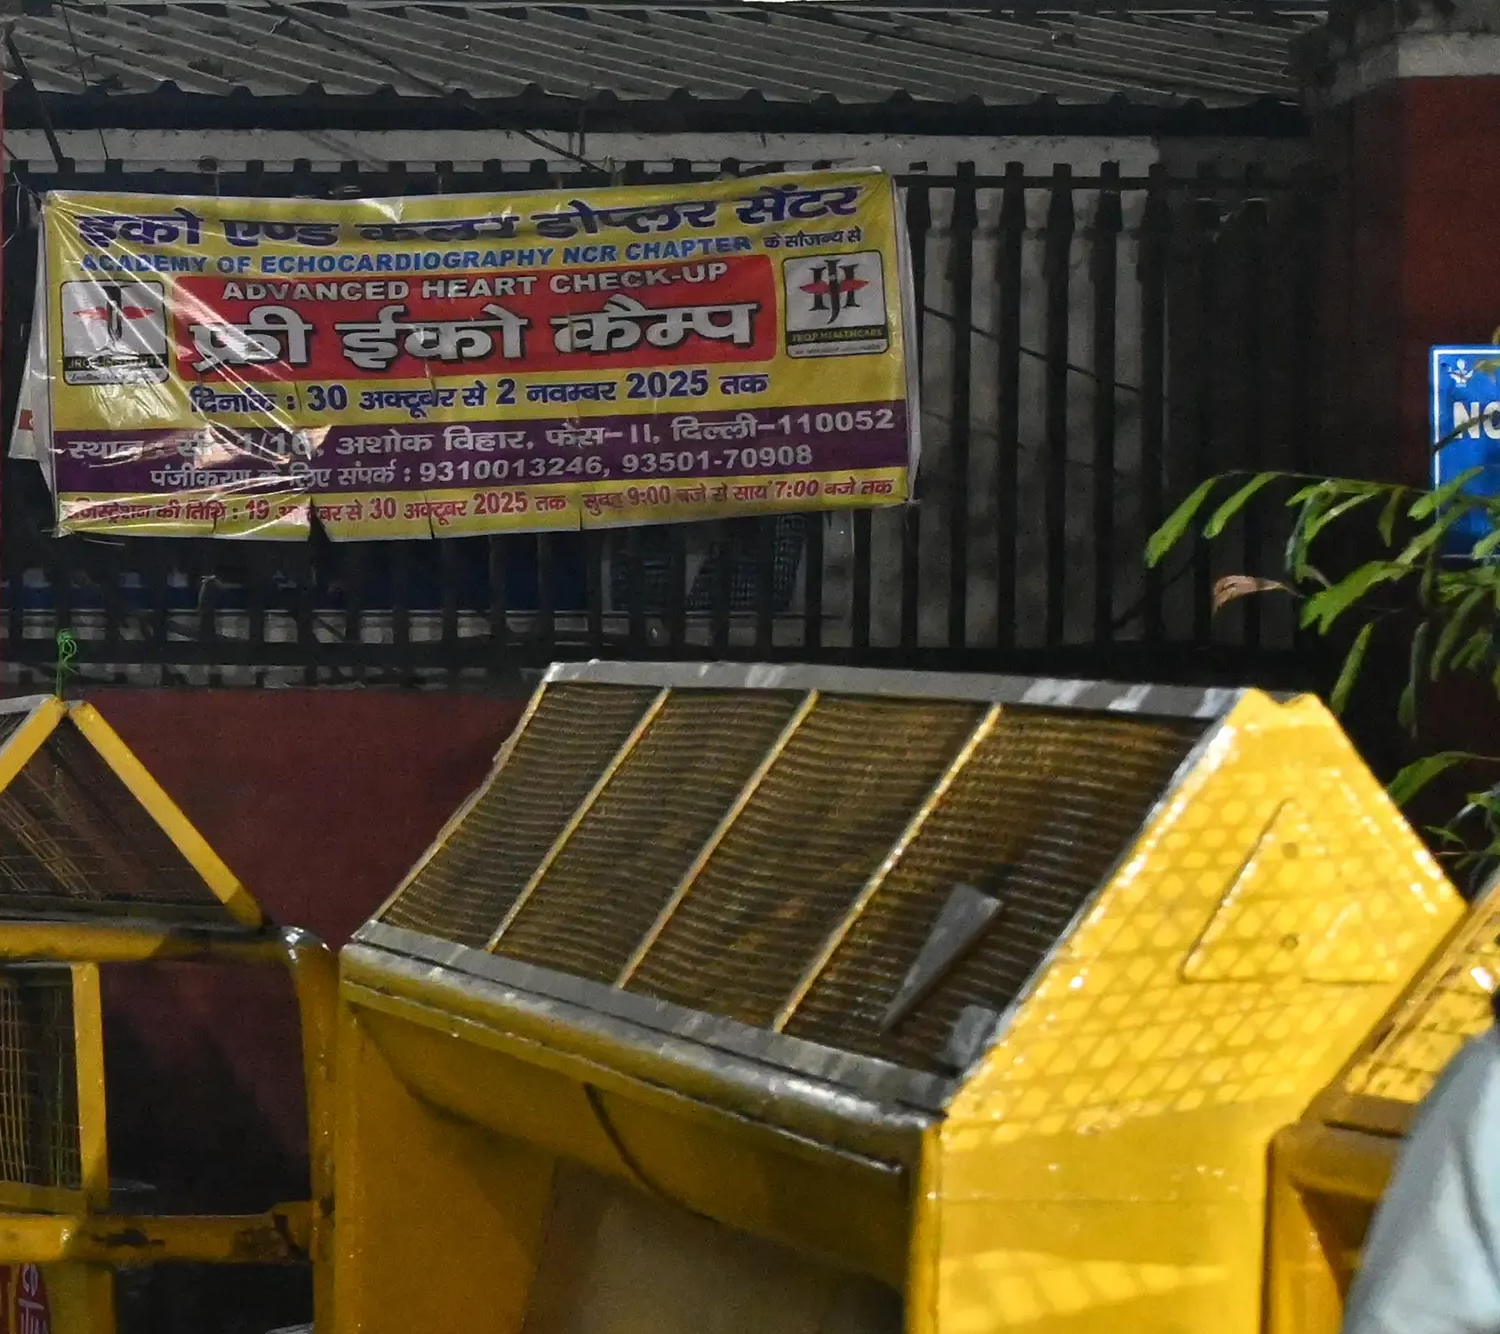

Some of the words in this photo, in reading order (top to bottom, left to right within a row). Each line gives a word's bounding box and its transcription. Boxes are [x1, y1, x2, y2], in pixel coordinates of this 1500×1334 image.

[219, 218, 340, 248] एण्ड
[735, 182, 864, 225] सेंटर
[79, 253, 208, 273] ACADEMY
[215, 254, 253, 274] OF
[260, 247, 555, 275] ECHOCARDIOGRAPHY
[562, 244, 617, 265] NCR
[624, 234, 752, 262] CHAPTER
[762, 233, 783, 250] के
[785, 229, 844, 249] सौजन्य
[845, 225, 862, 244] से
[221, 279, 409, 302] ADVANCED
[421, 275, 538, 300] HEART
[549, 261, 729, 297] CHECK-UP
[188, 304, 314, 373] फ्री
[335, 303, 528, 371] ईको
[550, 291, 762, 355] कैम्प
[68, 357, 97, 369] JRO
[189, 385, 278, 414] दिनांक
[307, 384, 348, 411] 30
[358, 388, 455, 419] अक्टूबर
[460, 380, 487, 408] से
[495, 378, 516, 406] 2
[525, 379, 619, 405] नवम्बर
[626, 368, 710, 400] 2025
[717, 371, 769, 397] तक
[335, 427, 437, 456] अशोक
[442, 425, 535, 452] विहार,
[669, 407, 896, 444] दिल्ली-110052
[288, 462, 332, 489] लिए
[338, 458, 398, 486] संपर्क
[418, 455, 612, 485] 9310013246,
[620, 443, 814, 476] 93501-70908
[245, 499, 270, 520] 19
[346, 498, 364, 521] से
[369, 496, 397, 520] 30
[402, 499, 468, 526] अक्टूबर
[472, 490, 529, 516] 2025
[534, 493, 567, 512] तक
[627, 485, 670, 506] 9:00
[774, 478, 820, 498] 7:00
[823, 477, 858, 497] बजे
[860, 478, 895, 496] तक
